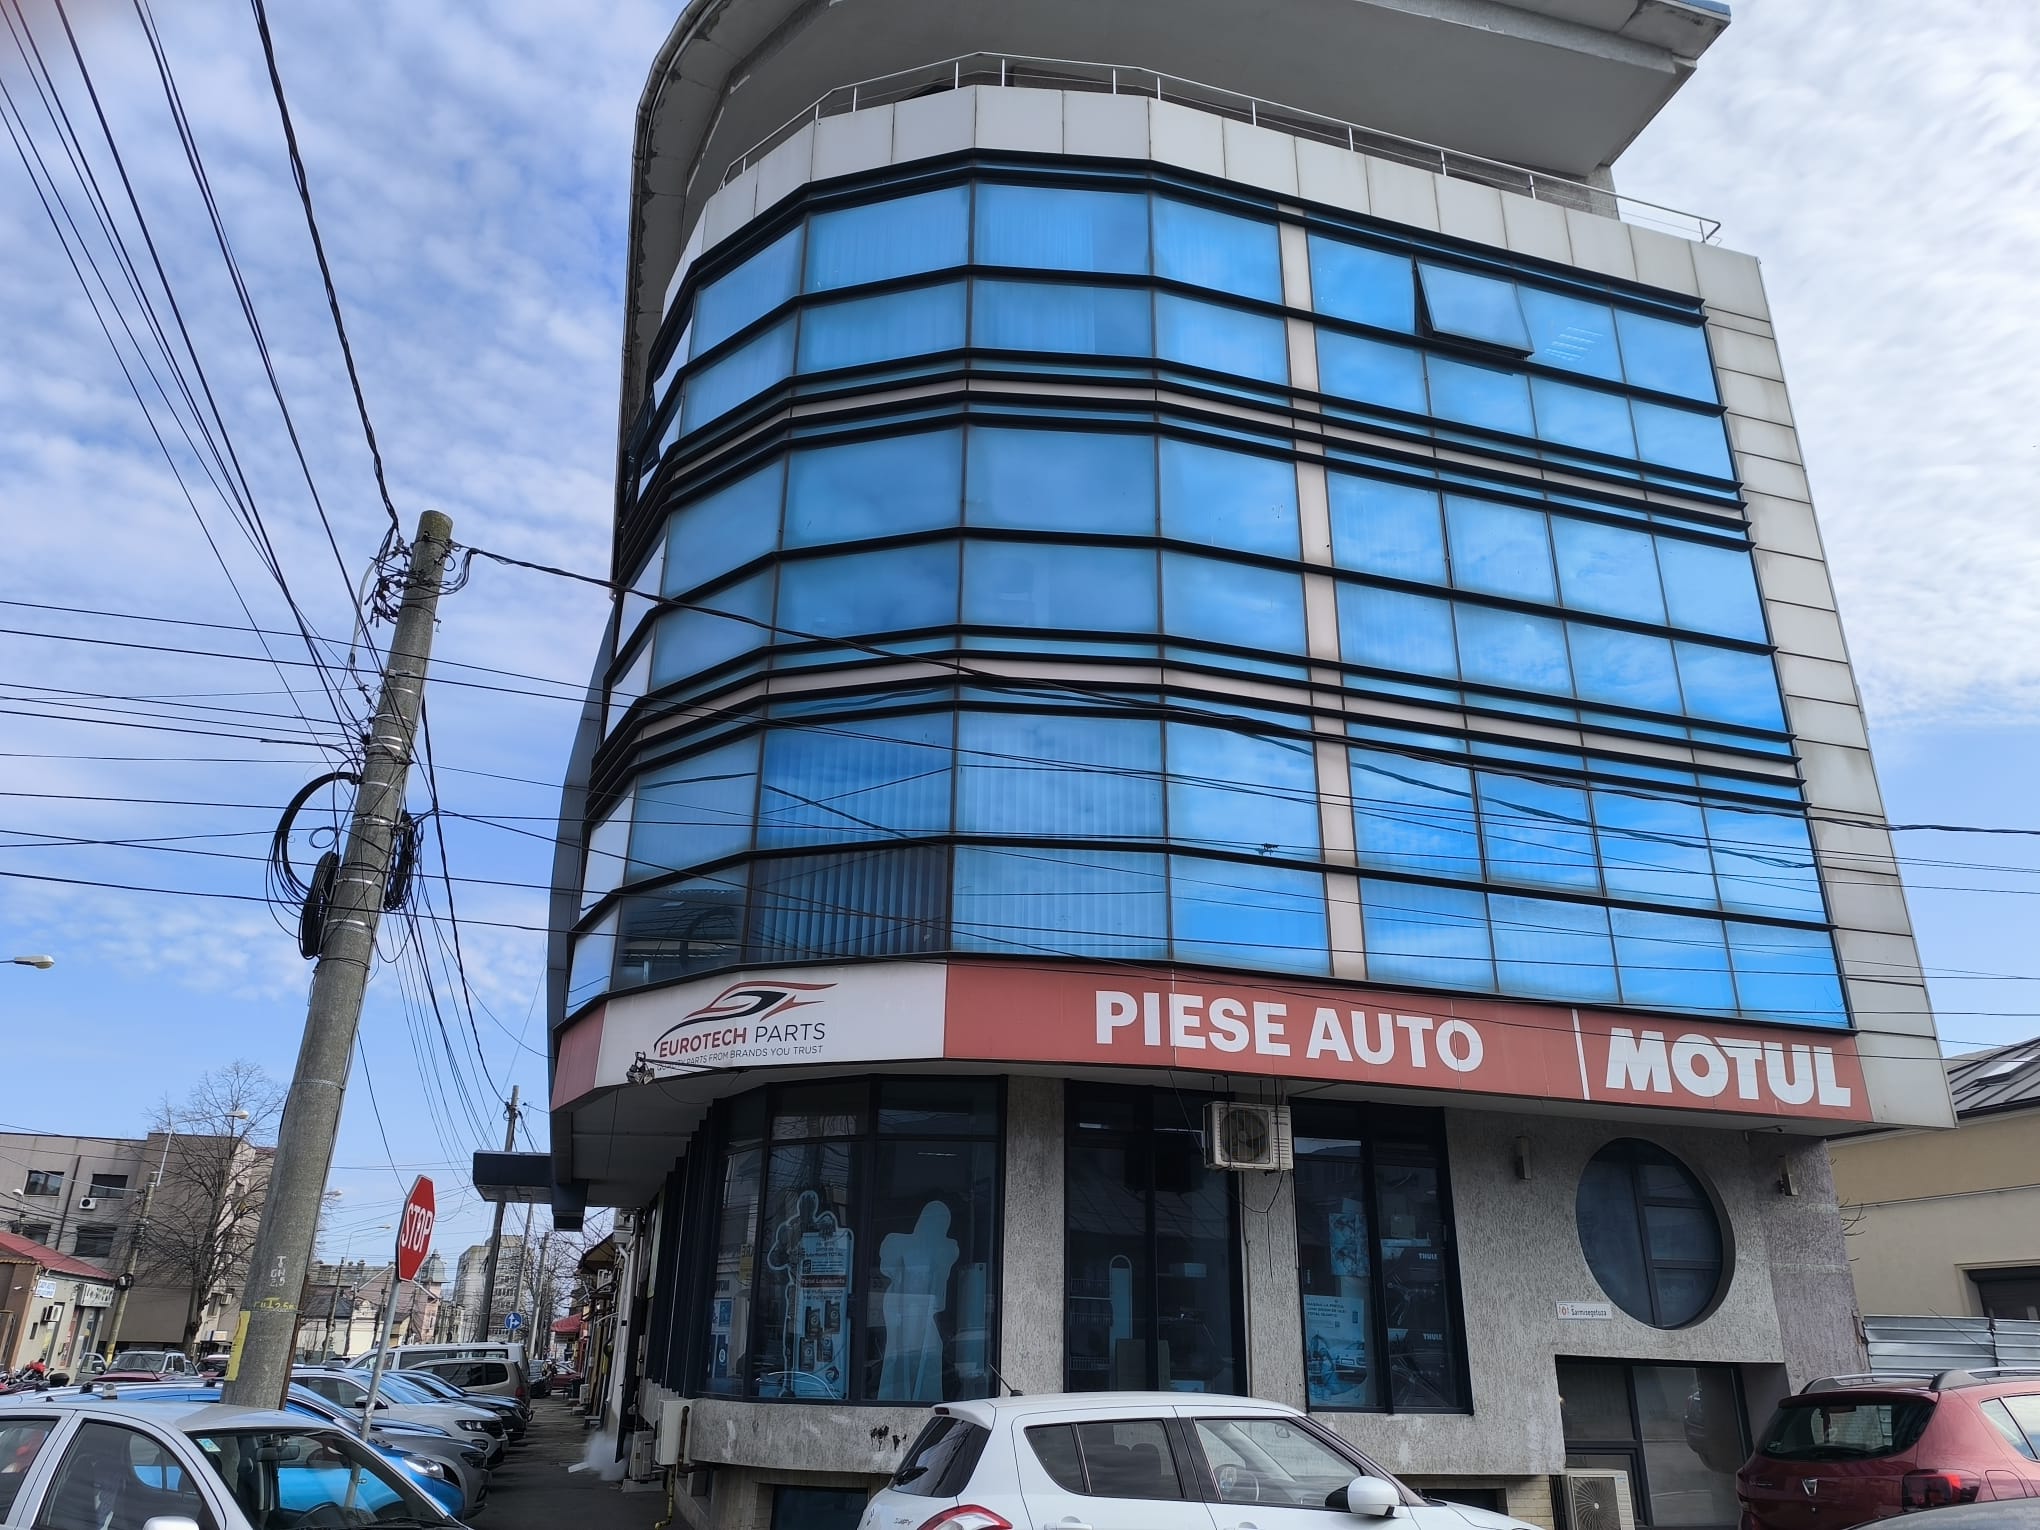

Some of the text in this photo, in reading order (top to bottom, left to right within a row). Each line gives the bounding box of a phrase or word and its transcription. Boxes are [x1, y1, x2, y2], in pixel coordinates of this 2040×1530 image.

[659, 1022, 826, 1058] EUROTECH PARTS
[708, 1051, 729, 1063] FROM
[730, 1048, 768, 1059] BRANDS
[770, 1047, 790, 1056] YOU
[793, 1045, 823, 1055] TRUST
[1093, 989, 1485, 1073] PIESE AUTO
[1605, 1026, 1852, 1109] MOTUL
[401, 1202, 433, 1253] STOP
